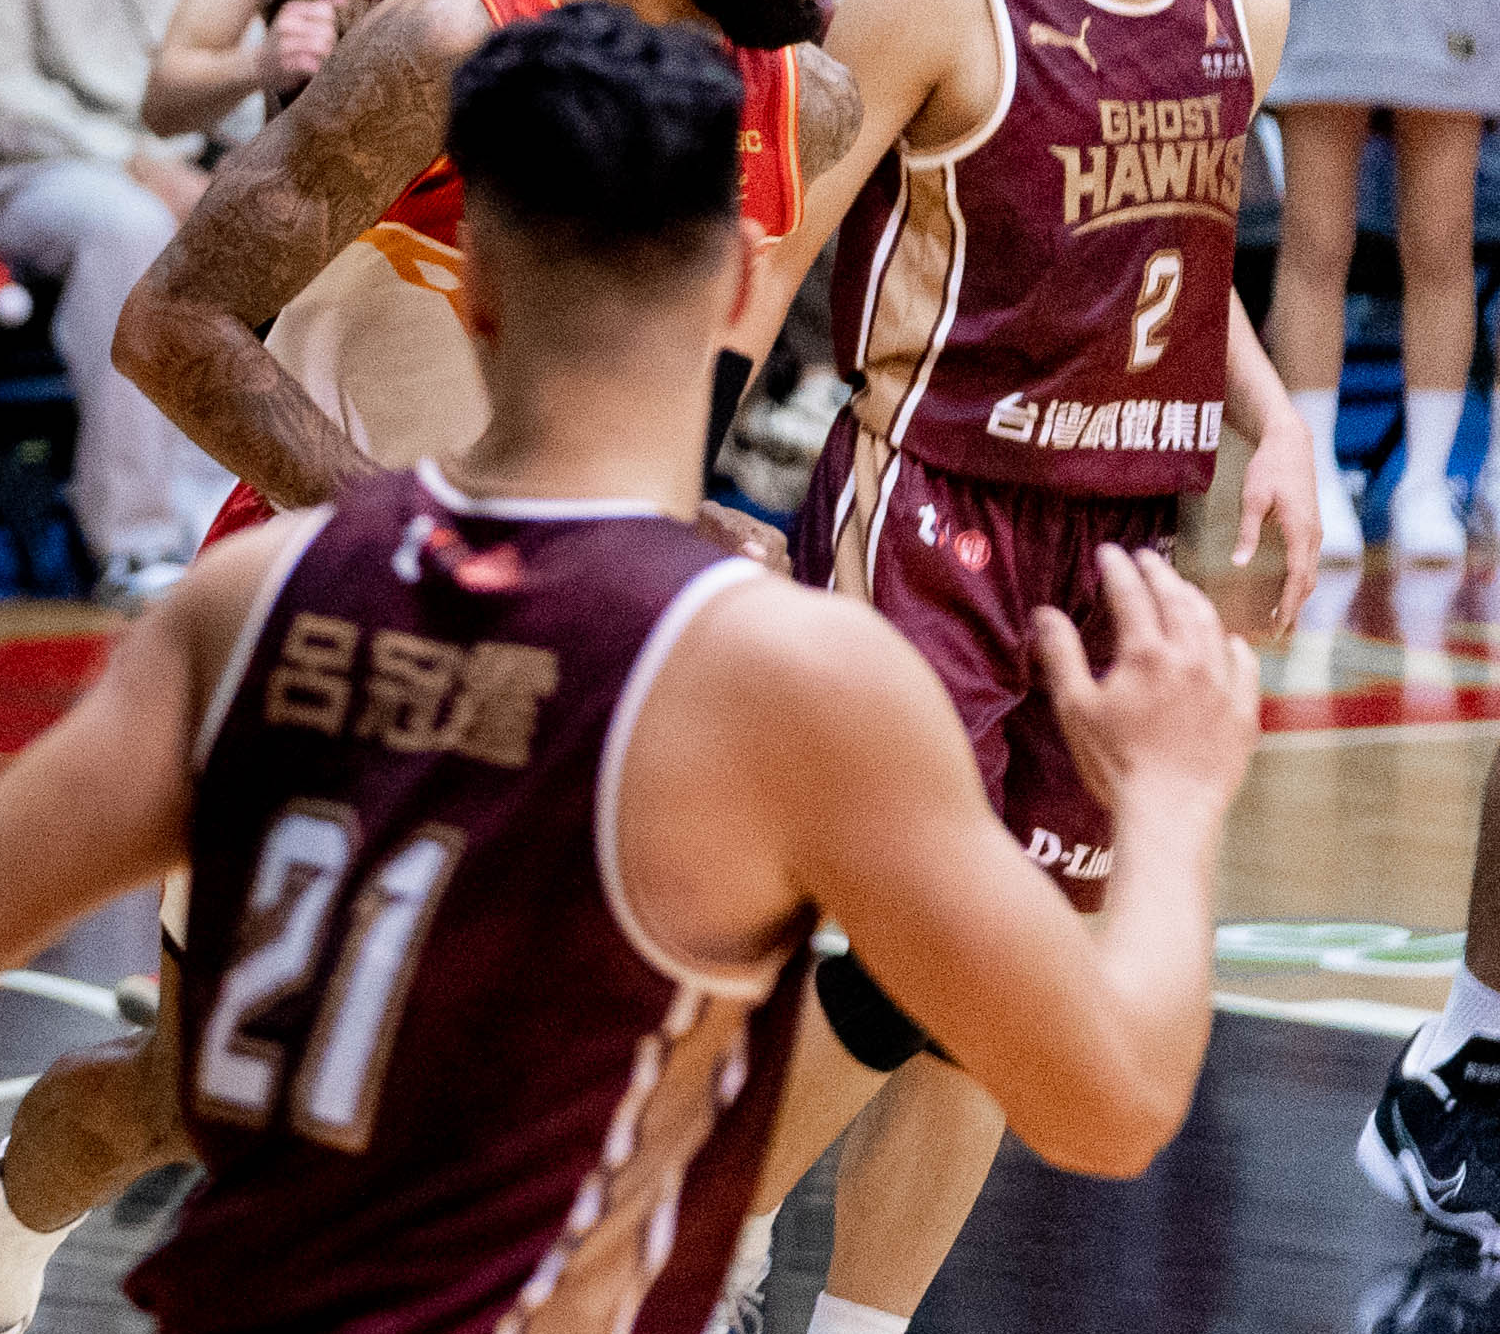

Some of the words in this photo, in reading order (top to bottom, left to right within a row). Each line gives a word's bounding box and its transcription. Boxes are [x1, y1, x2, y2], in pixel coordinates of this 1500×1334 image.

[1099, 94, 1221, 143] GHOST
[1051, 134, 1247, 224] HAWKS
[1127, 248, 1185, 374] 2
[190, 795, 468, 1155] 21
